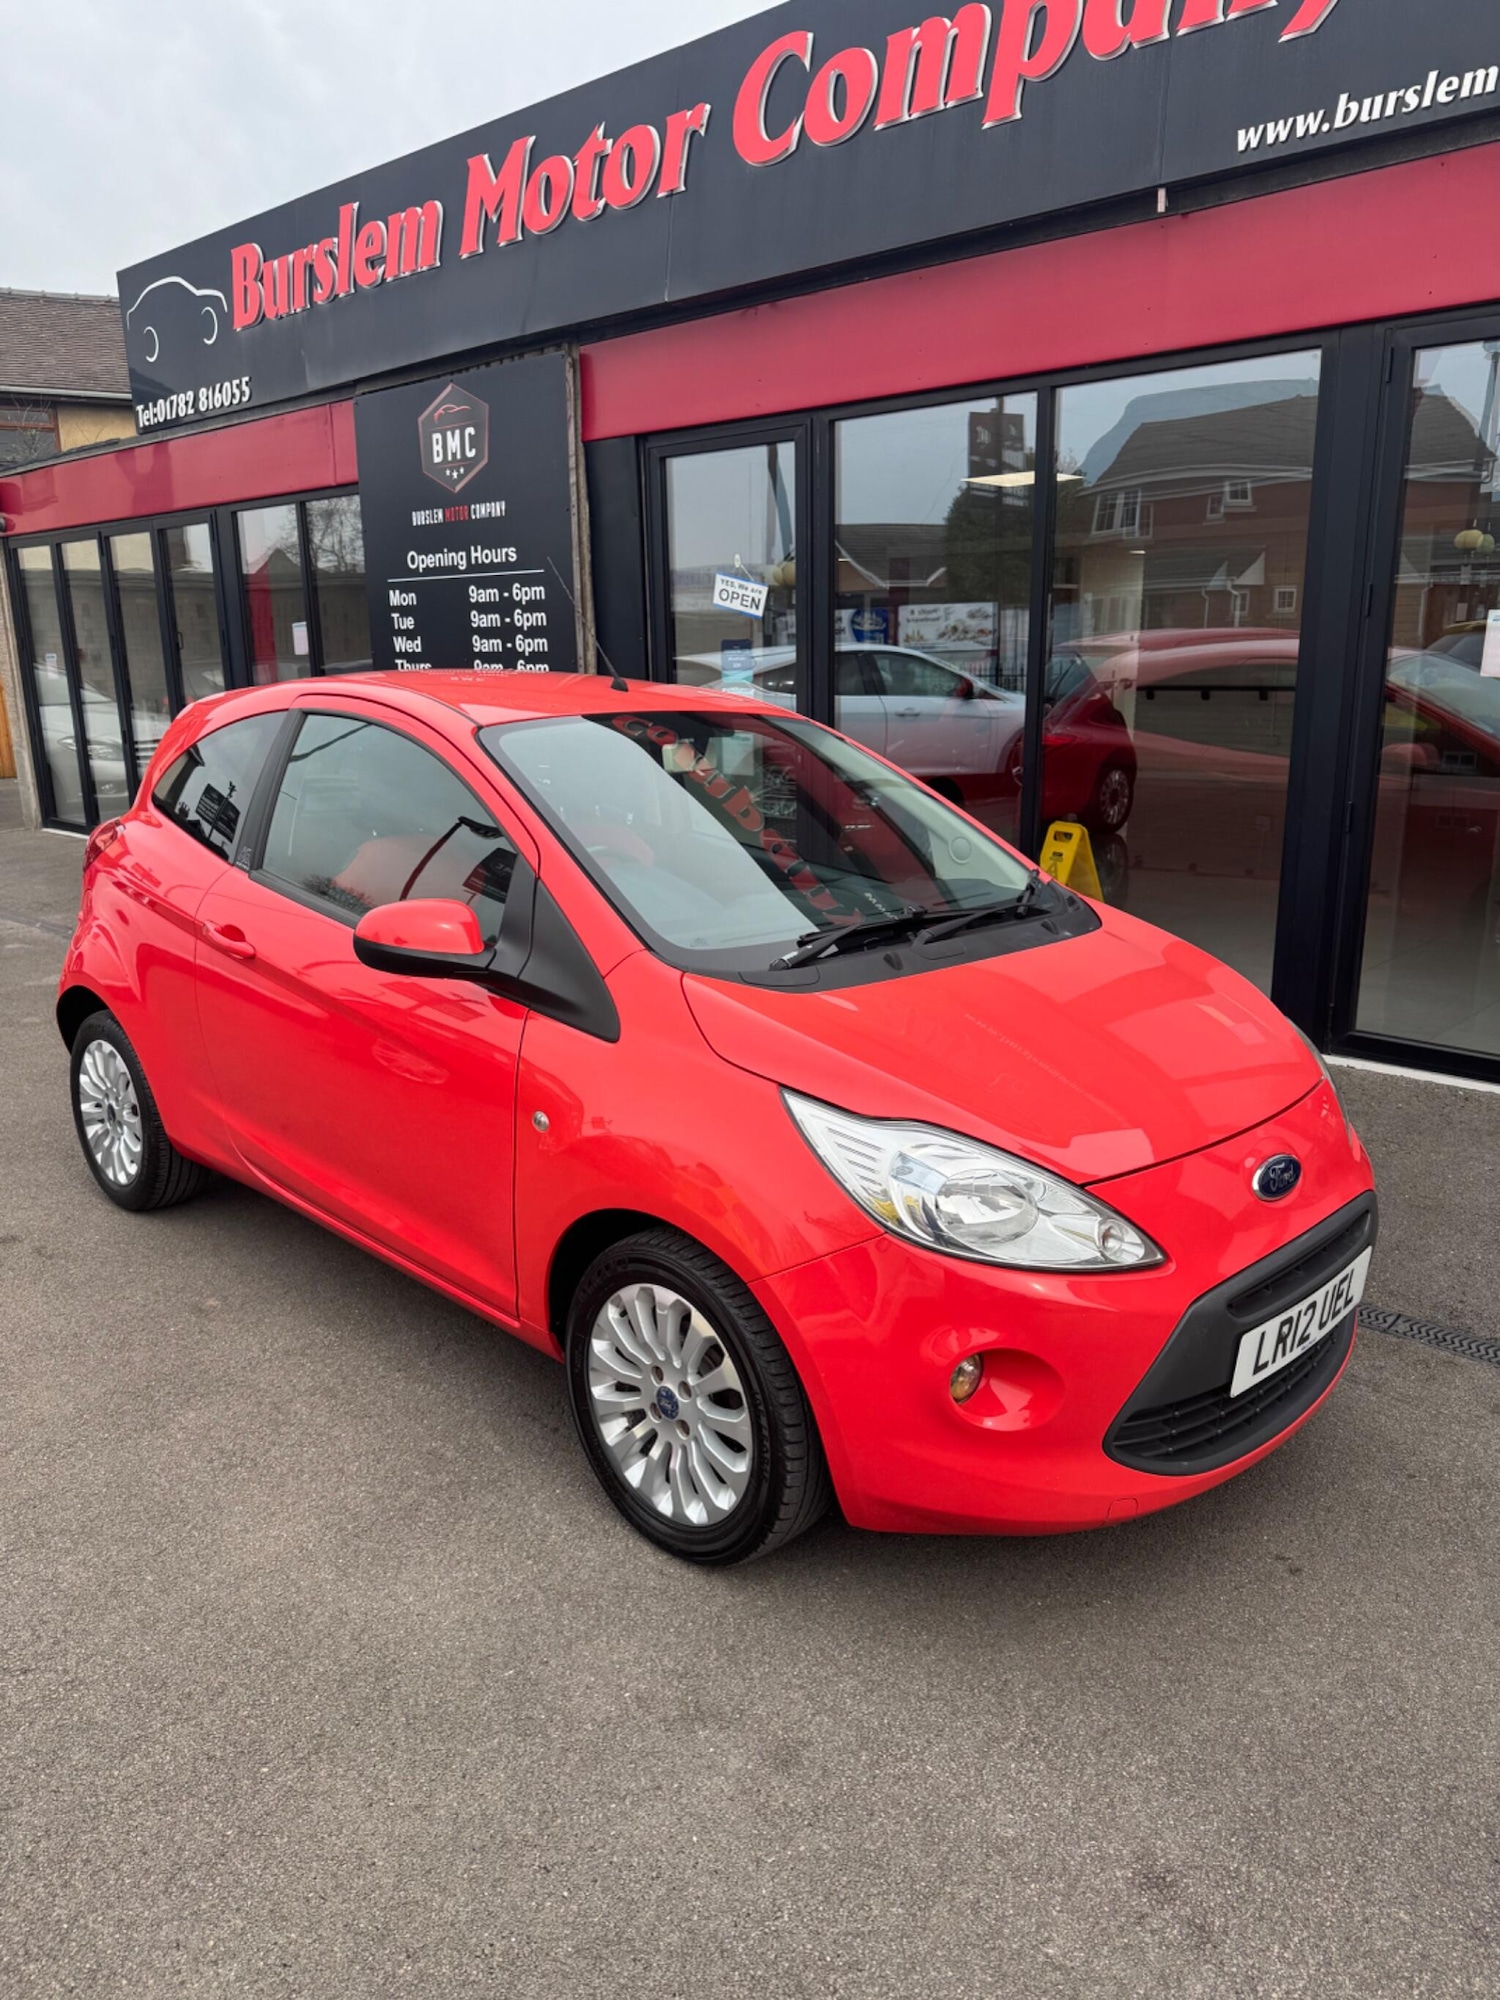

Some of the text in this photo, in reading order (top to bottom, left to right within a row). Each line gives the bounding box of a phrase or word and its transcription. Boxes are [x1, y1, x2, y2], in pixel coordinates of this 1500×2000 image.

[1236, 64, 1500, 153] www.burslem
[230, 0, 1338, 331] Burslem Motor Compa
[136, 376, 251, 428] Tel:01782 816055
[432, 426, 476, 463] BMC
[412, 500, 505, 526] BURSLEM MOTOR COMPANY
[407, 545, 517, 573] Opening Hours
[388, 589, 417, 606] Mon
[468, 585, 499, 603] 9am
[512, 583, 545, 605] 6pm
[719, 588, 761, 610] OPEN
[391, 612, 415, 630] Tue
[470, 610, 501, 628] 9am
[513, 608, 547, 631] 6pm
[393, 636, 422, 653] Wed
[472, 635, 502, 653] 9am
[515, 634, 548, 657] 6pm
[1269, 1162, 1294, 1192] Ford
[1252, 1268, 1355, 1376] LR12 UEL
